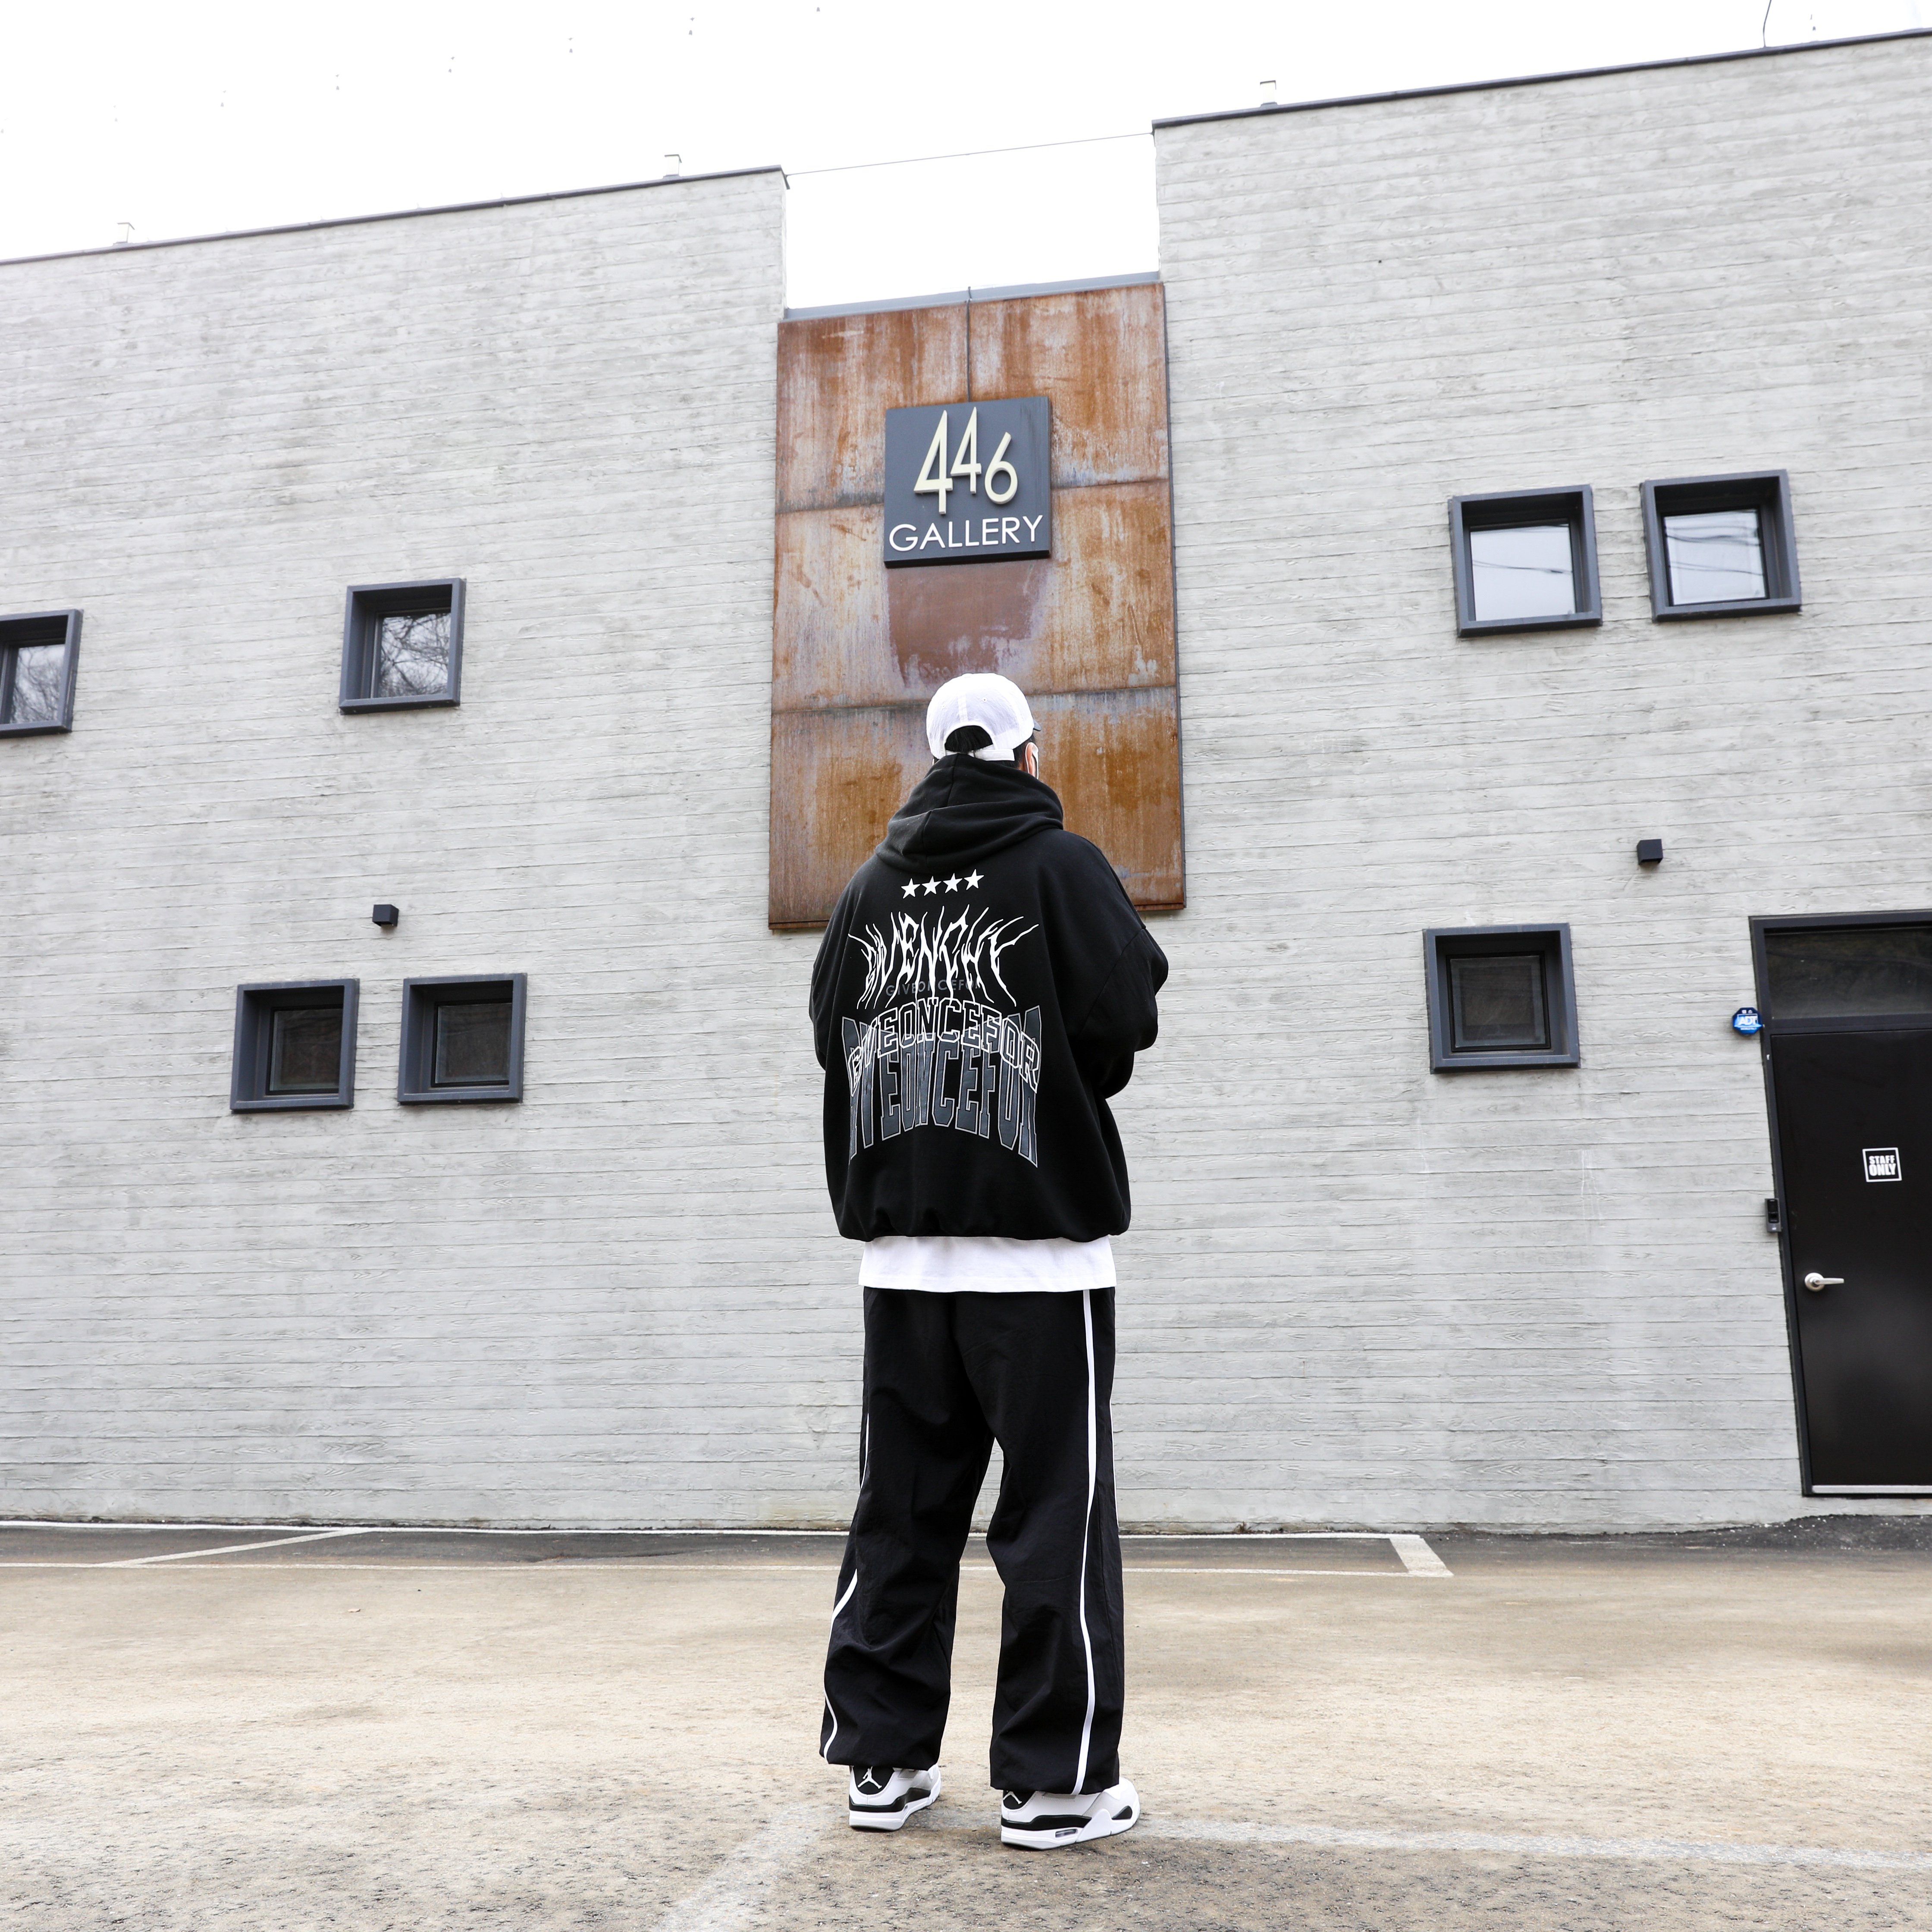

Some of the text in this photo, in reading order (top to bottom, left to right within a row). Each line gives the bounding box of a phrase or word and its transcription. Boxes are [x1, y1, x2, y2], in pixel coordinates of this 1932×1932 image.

[913, 406, 1018, 514] 446
[889, 515, 1043, 552] GALLERY
[1738, 1016, 1758, 1026] ADT
[848, 997, 1040, 1094] GVEONCEFOR
[1869, 1155, 1895, 1164] STAFF
[1869, 1163, 1896, 1176] ONLY
